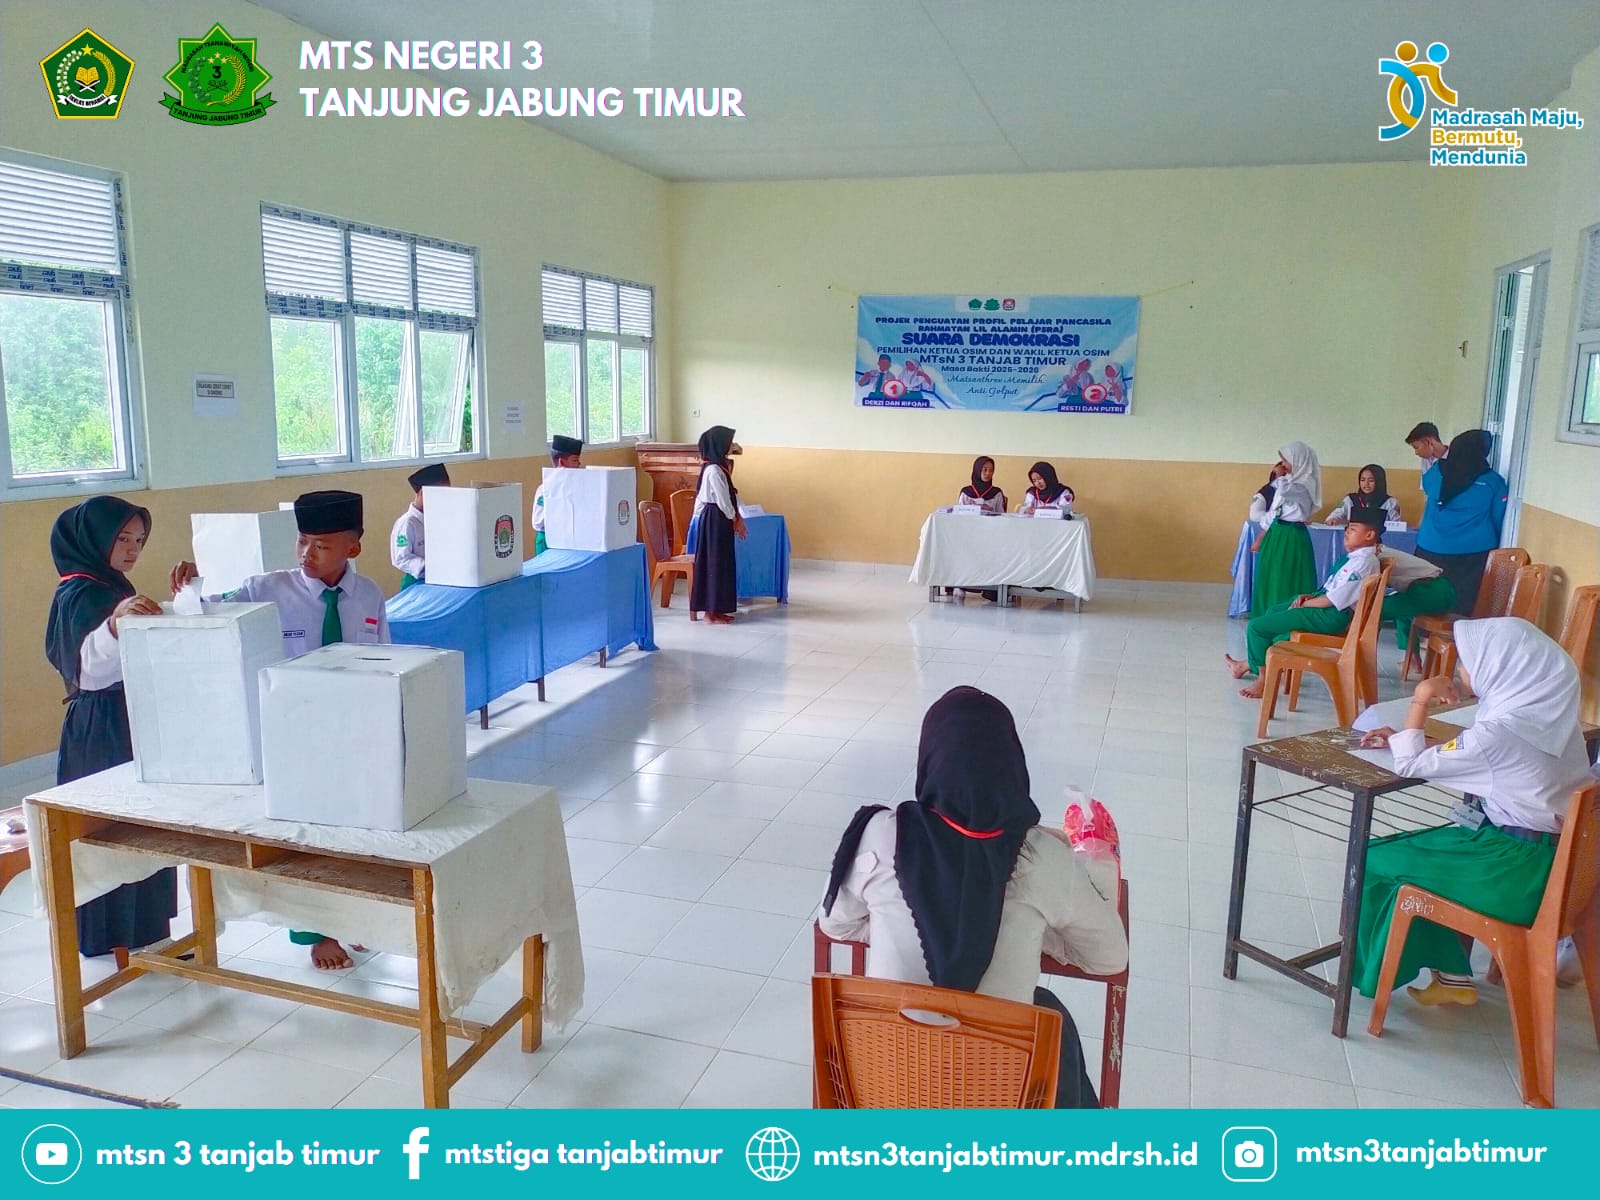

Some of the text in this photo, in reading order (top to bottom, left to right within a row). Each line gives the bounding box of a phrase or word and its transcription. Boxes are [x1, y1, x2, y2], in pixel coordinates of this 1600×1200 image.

[902, 332, 1080, 347] SUARA DEMOKRASI
[877, 346, 927, 354] PEMILIHAN
[928, 347, 960, 355] KETUA
[961, 347, 987, 355] OSIM
[1012, 348, 1046, 356] WAKIL
[1082, 349, 1110, 357] OSIM
[919, 355, 1067, 366] MTsN 3 TANJAB TIMUR
[889, 384, 898, 395] 1
[1089, 388, 1102, 400] 2
